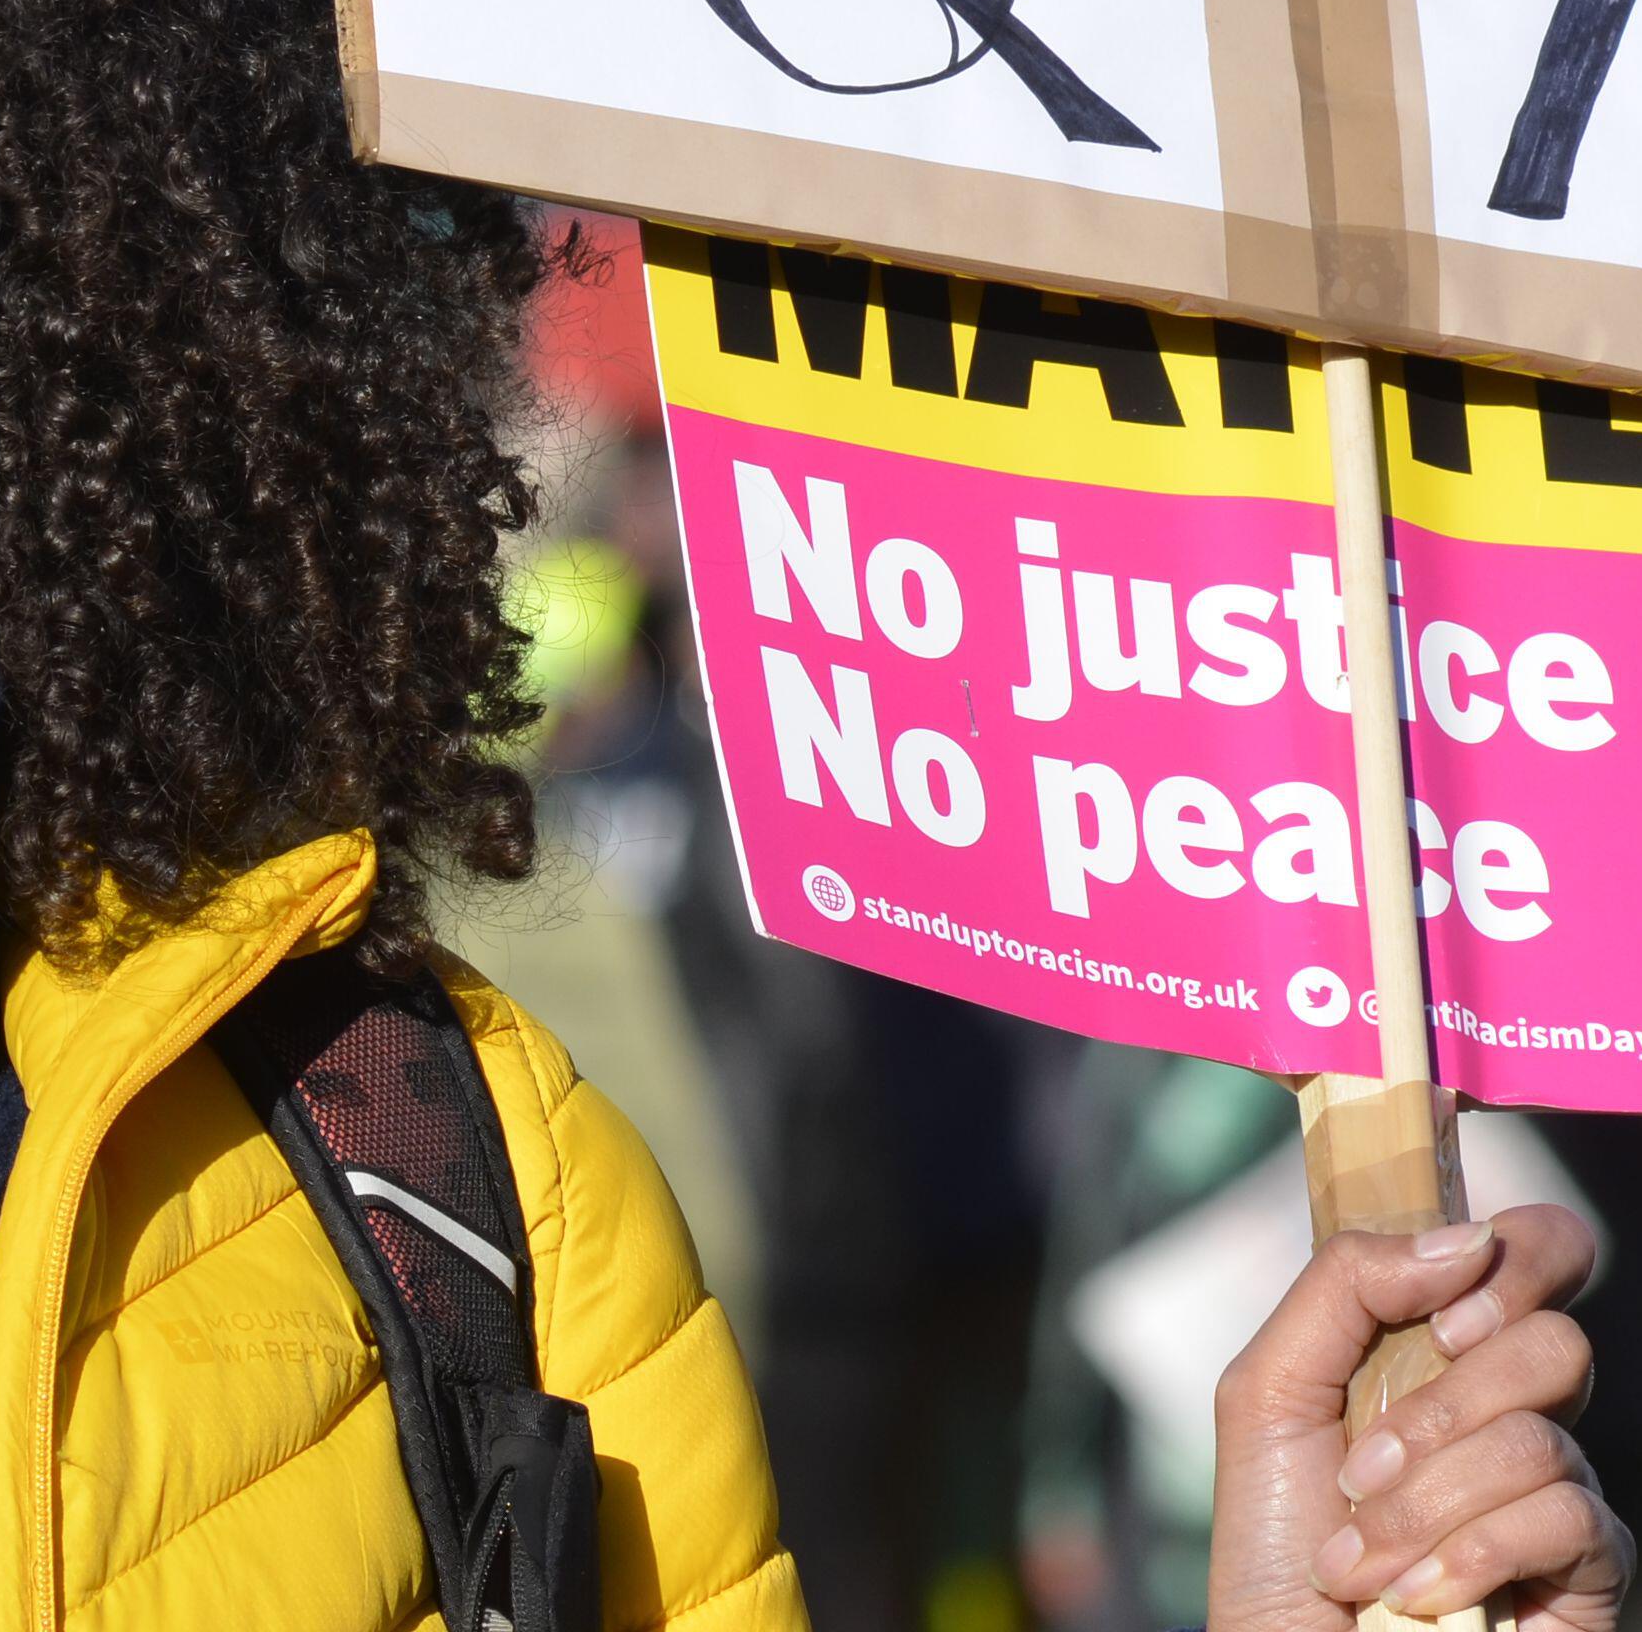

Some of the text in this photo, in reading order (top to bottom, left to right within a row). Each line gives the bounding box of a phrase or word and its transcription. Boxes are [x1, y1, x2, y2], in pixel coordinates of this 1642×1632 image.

[732, 458, 964, 660] No
[759, 644, 987, 848] No
[861, 893, 1261, 1011] standuptoracism.org.uk
[212, 1340, 367, 1375] WAREHOUS
